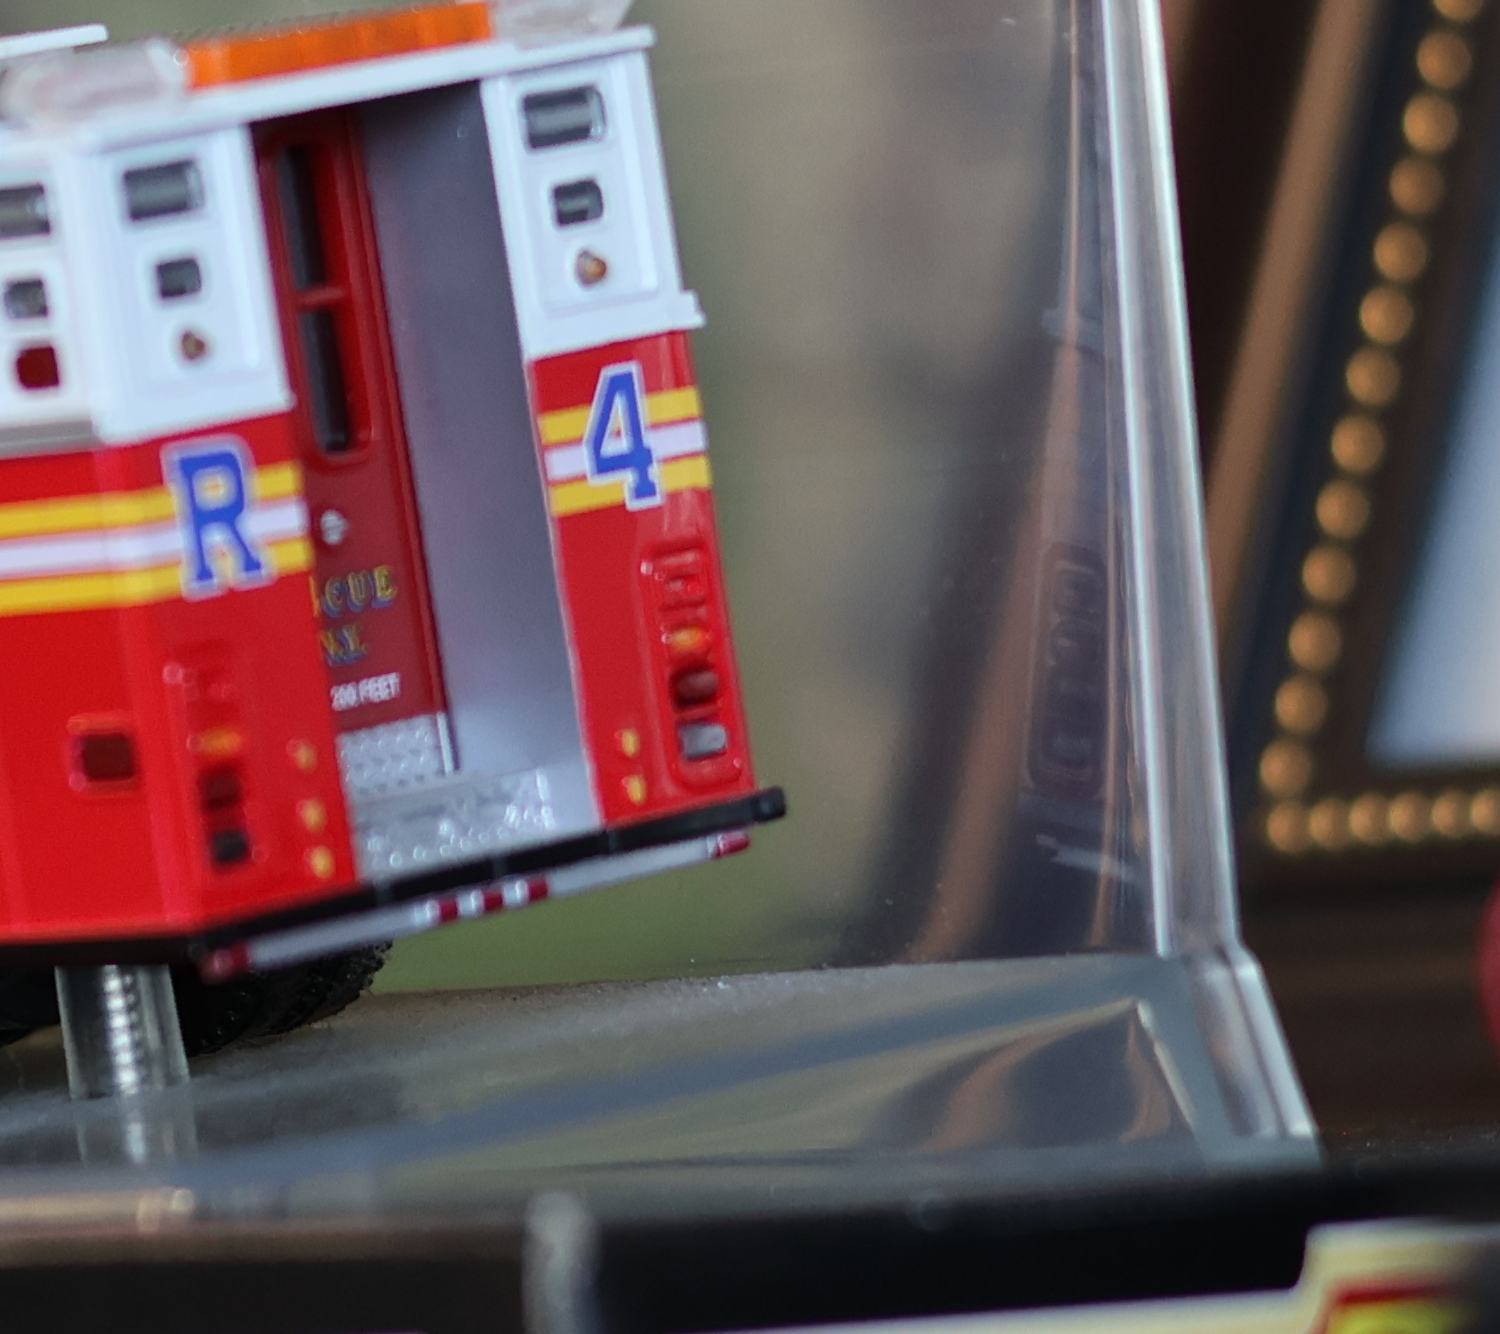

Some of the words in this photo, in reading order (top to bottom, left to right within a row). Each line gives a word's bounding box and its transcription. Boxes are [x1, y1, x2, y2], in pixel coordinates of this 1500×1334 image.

[583, 364, 661, 508] 4
[168, 440, 270, 595] R
[309, 565, 398, 619] CUE
